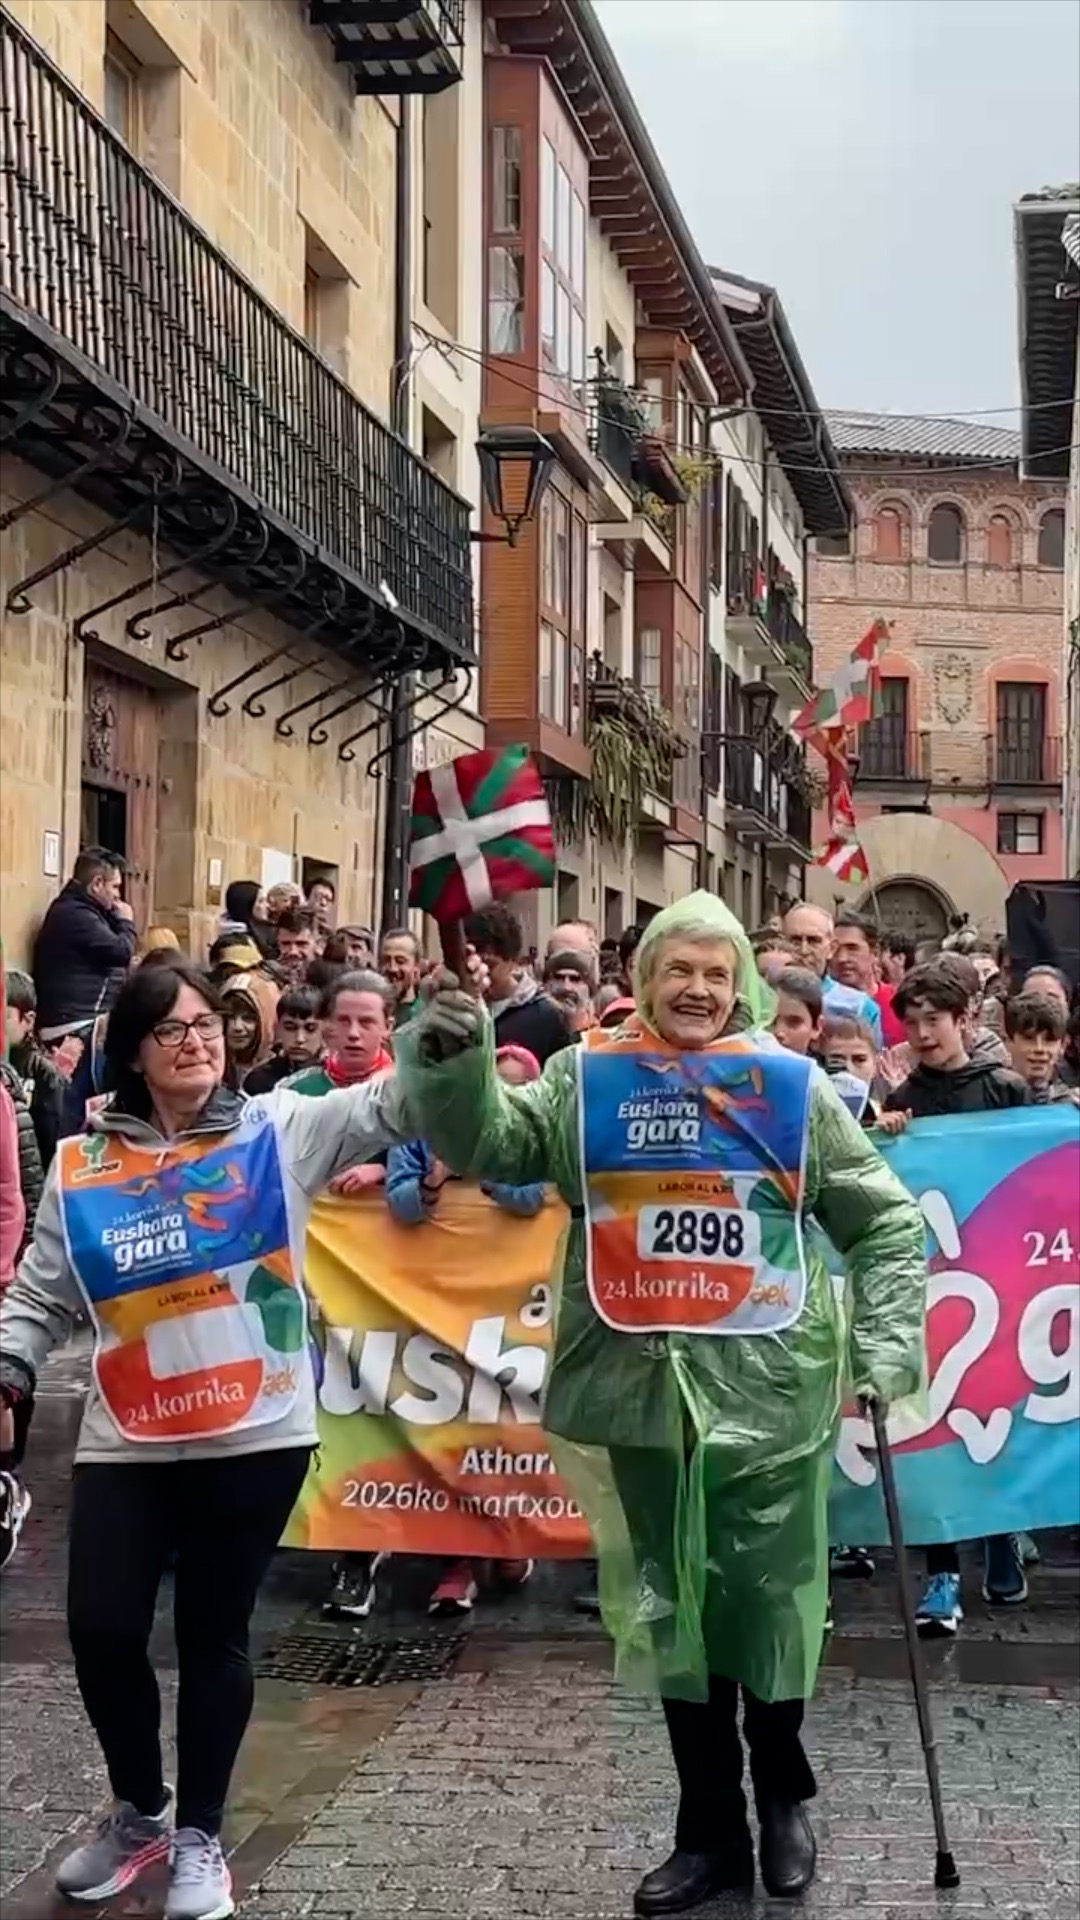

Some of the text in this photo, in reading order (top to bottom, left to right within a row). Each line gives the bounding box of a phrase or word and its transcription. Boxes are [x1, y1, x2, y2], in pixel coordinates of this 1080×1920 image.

[617, 1098, 699, 1119] Euskara
[626, 1119, 701, 1150] gara
[101, 1213, 183, 1246] Euskara
[652, 1210, 744, 1258] 2898
[114, 1230, 188, 1273] gara
[751, 1278, 790, 1306] aek
[340, 1480, 449, 1511] 2026ko
